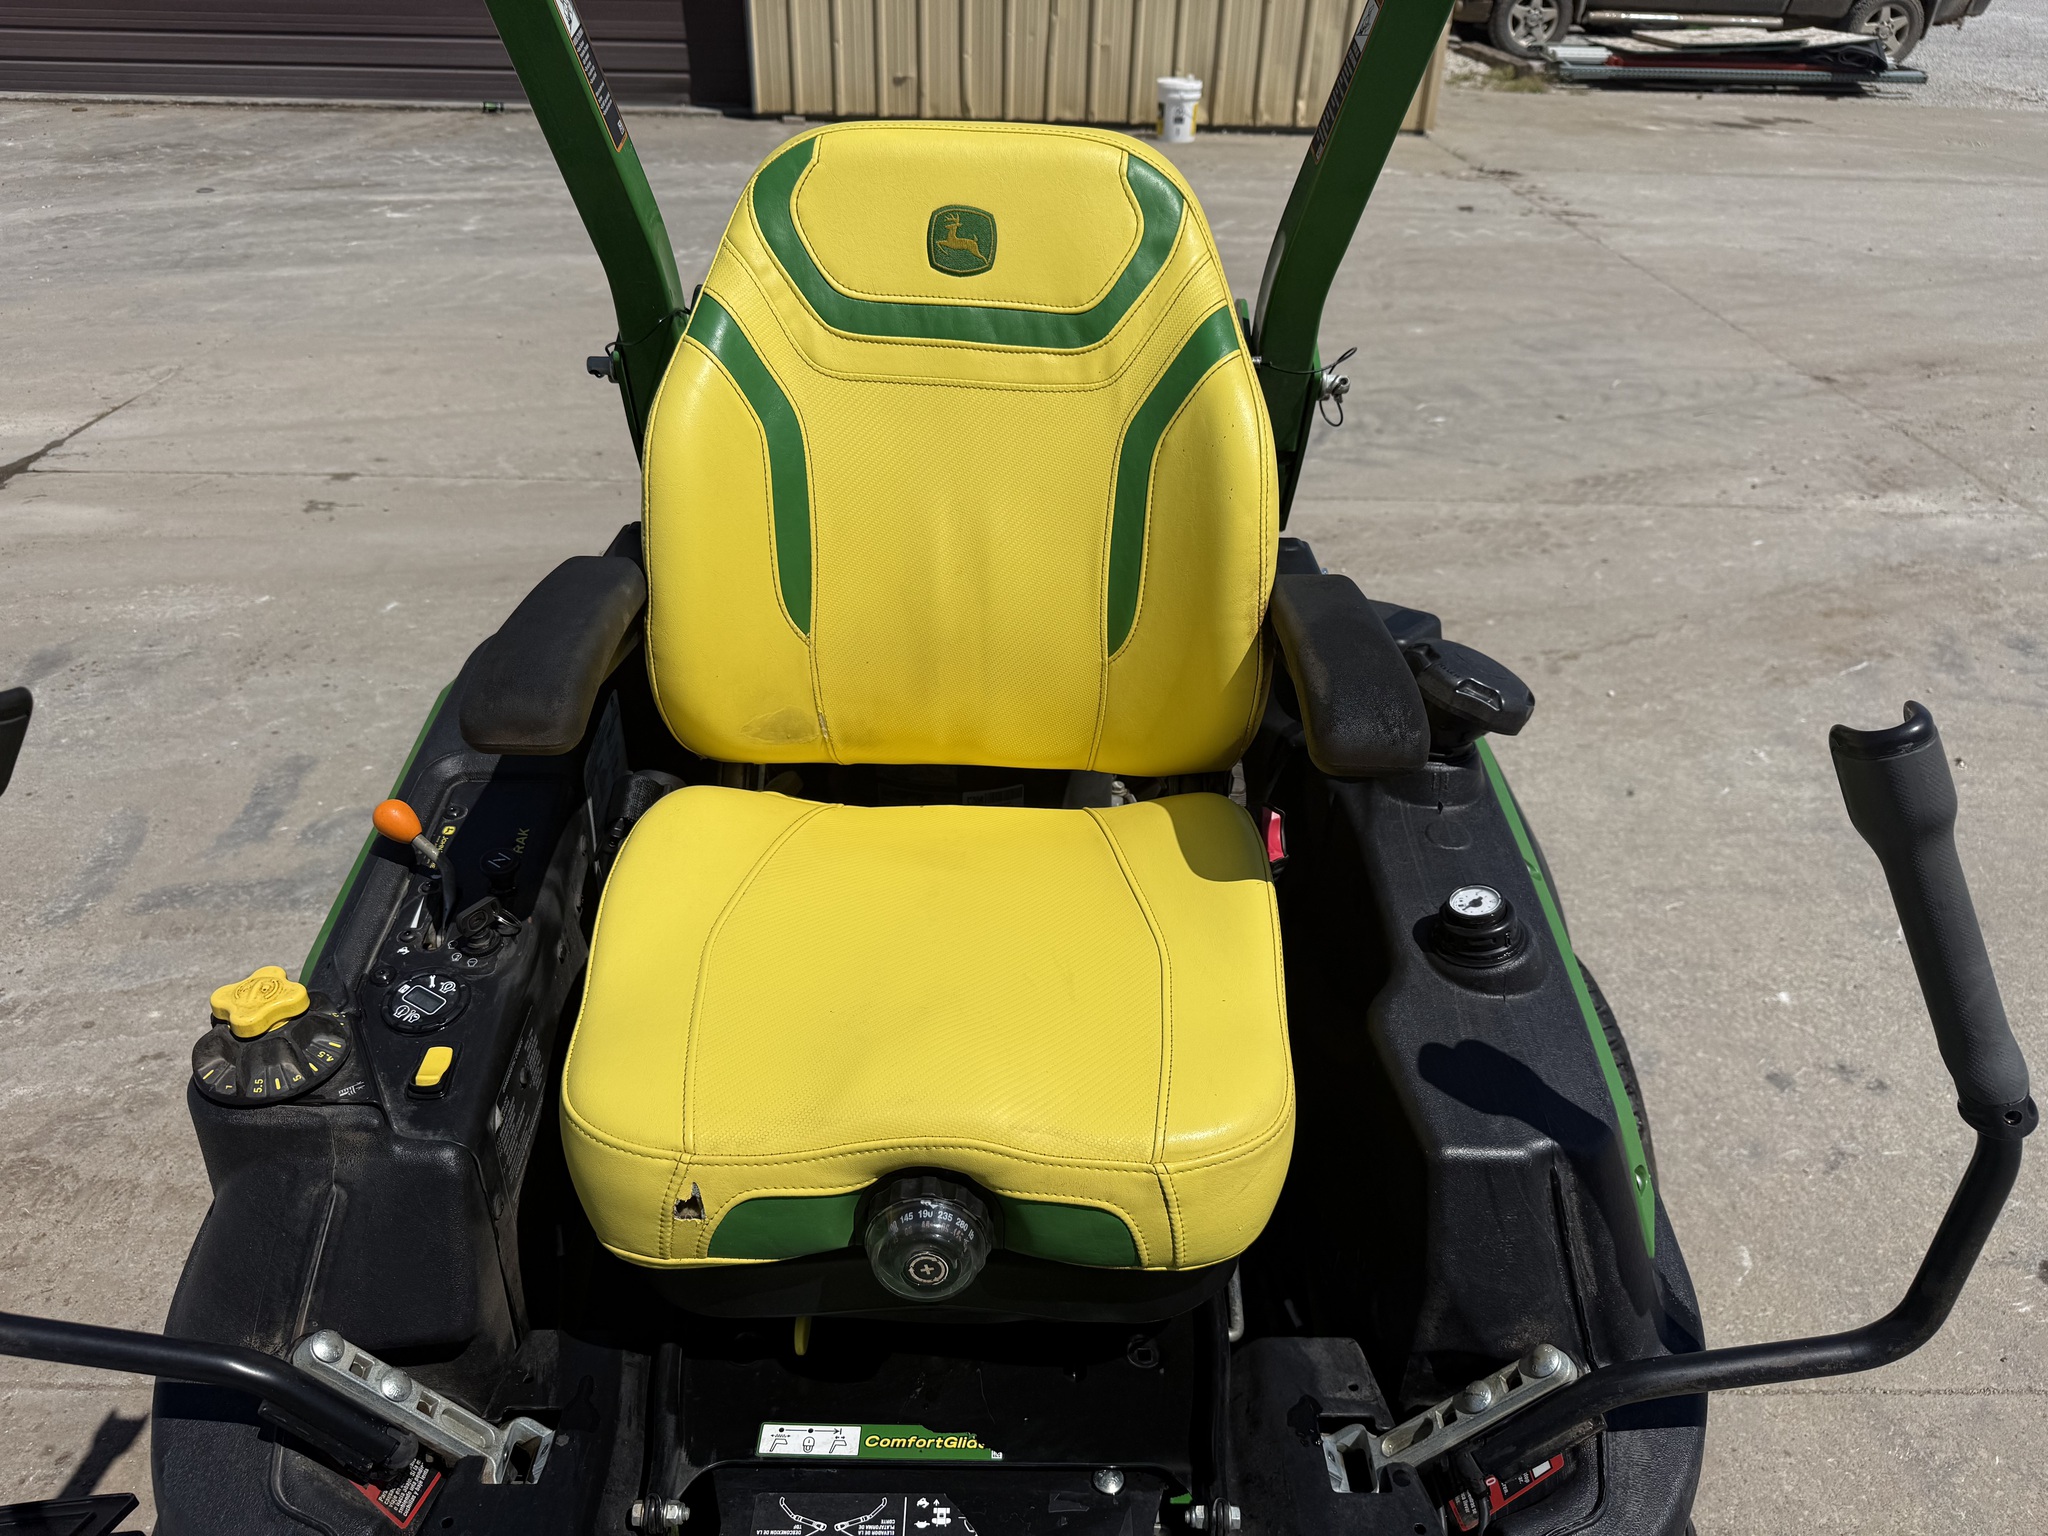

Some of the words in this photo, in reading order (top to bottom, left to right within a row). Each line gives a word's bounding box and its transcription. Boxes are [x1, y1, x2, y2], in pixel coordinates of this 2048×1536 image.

[253, 1079, 264, 1093] 5.5
[900, 1212, 914, 1224] 145
[938, 1210, 953, 1222] 235
[956, 1218, 968, 1231] 280
